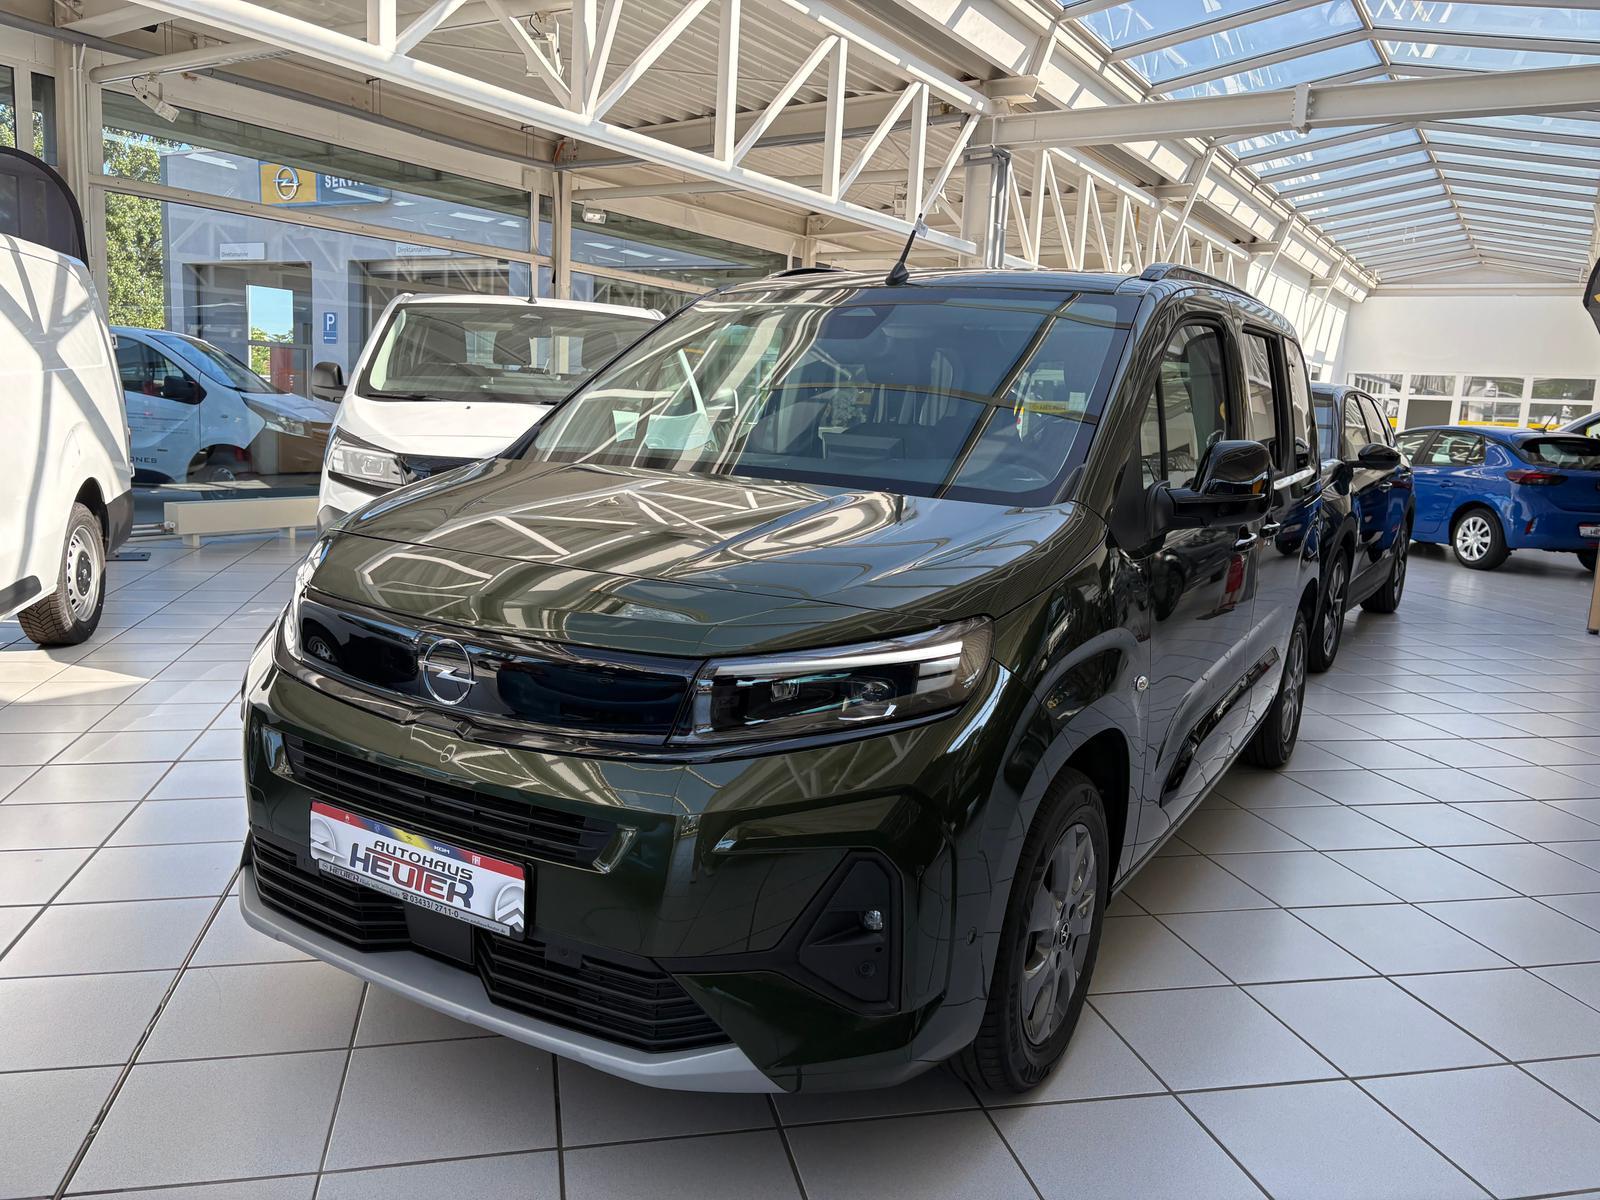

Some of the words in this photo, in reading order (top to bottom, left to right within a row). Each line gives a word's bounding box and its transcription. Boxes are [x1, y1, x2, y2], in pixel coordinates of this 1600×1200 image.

[326, 313, 335, 331] P
[374, 840, 474, 881] AUTOHAUS
[349, 842, 475, 909] HEUTER
[434, 904, 459, 918] 2711-0
